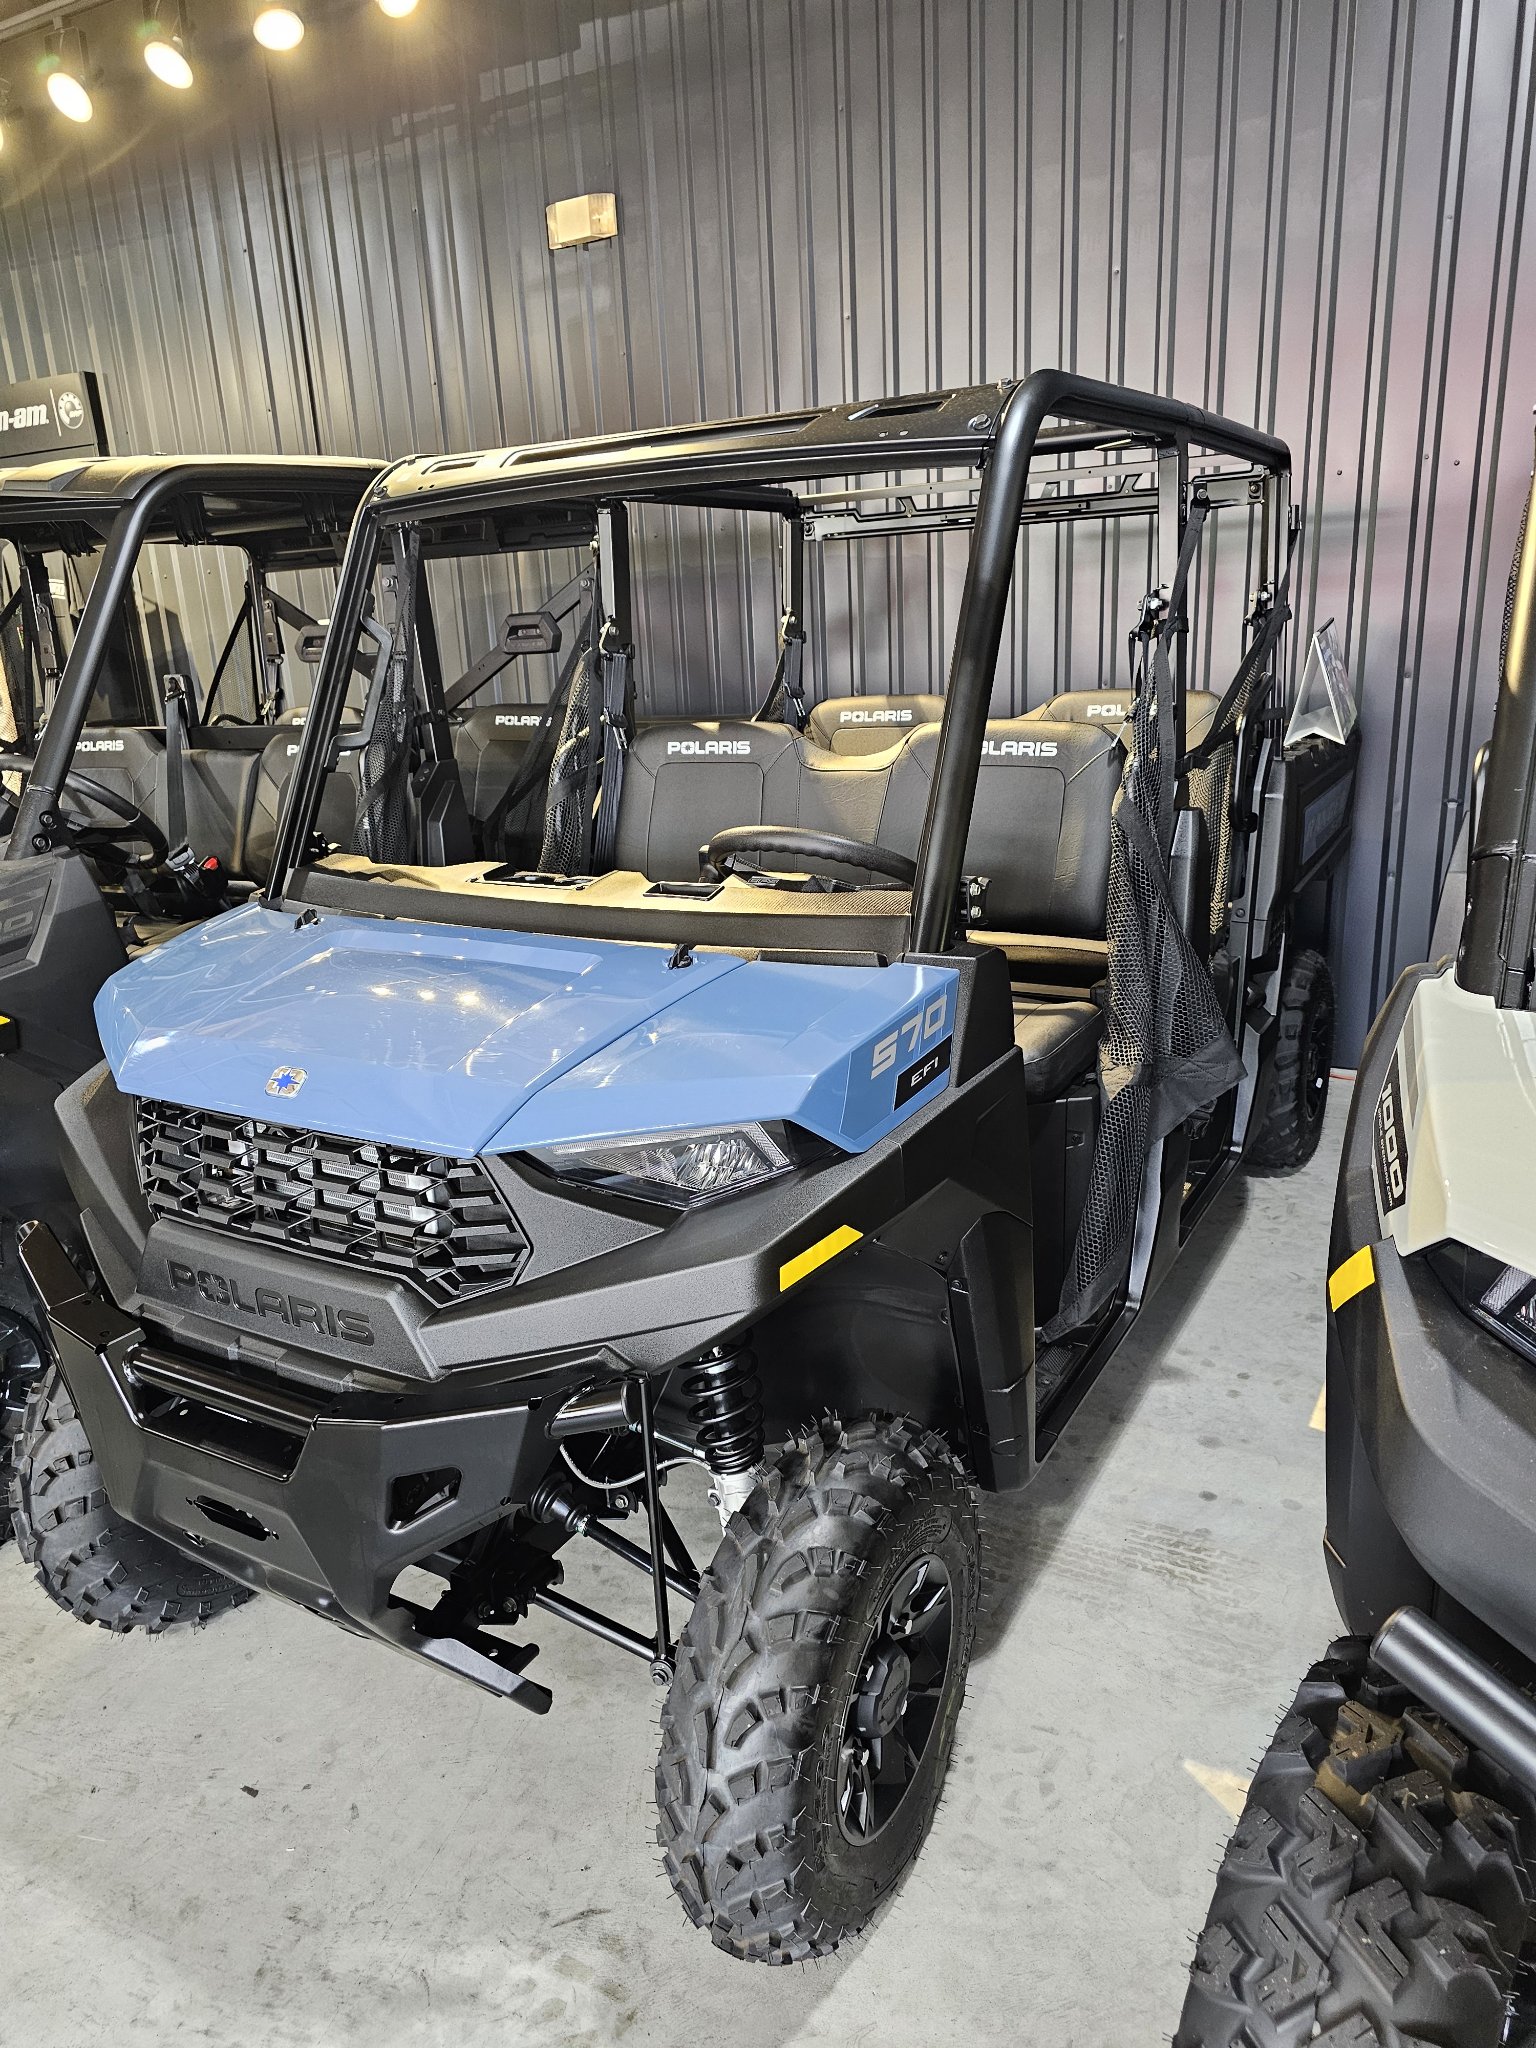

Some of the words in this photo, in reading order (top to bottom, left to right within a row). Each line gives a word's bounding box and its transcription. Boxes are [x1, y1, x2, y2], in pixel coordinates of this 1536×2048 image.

[839, 709, 913, 723] POLARIS
[667, 740, 751, 755] POLARIS
[870, 994, 948, 1081] 570
[910, 1056, 939, 1088] EFI
[1382, 1082, 1404, 1199] 1000
[165, 1259, 375, 1347] POLARIS
